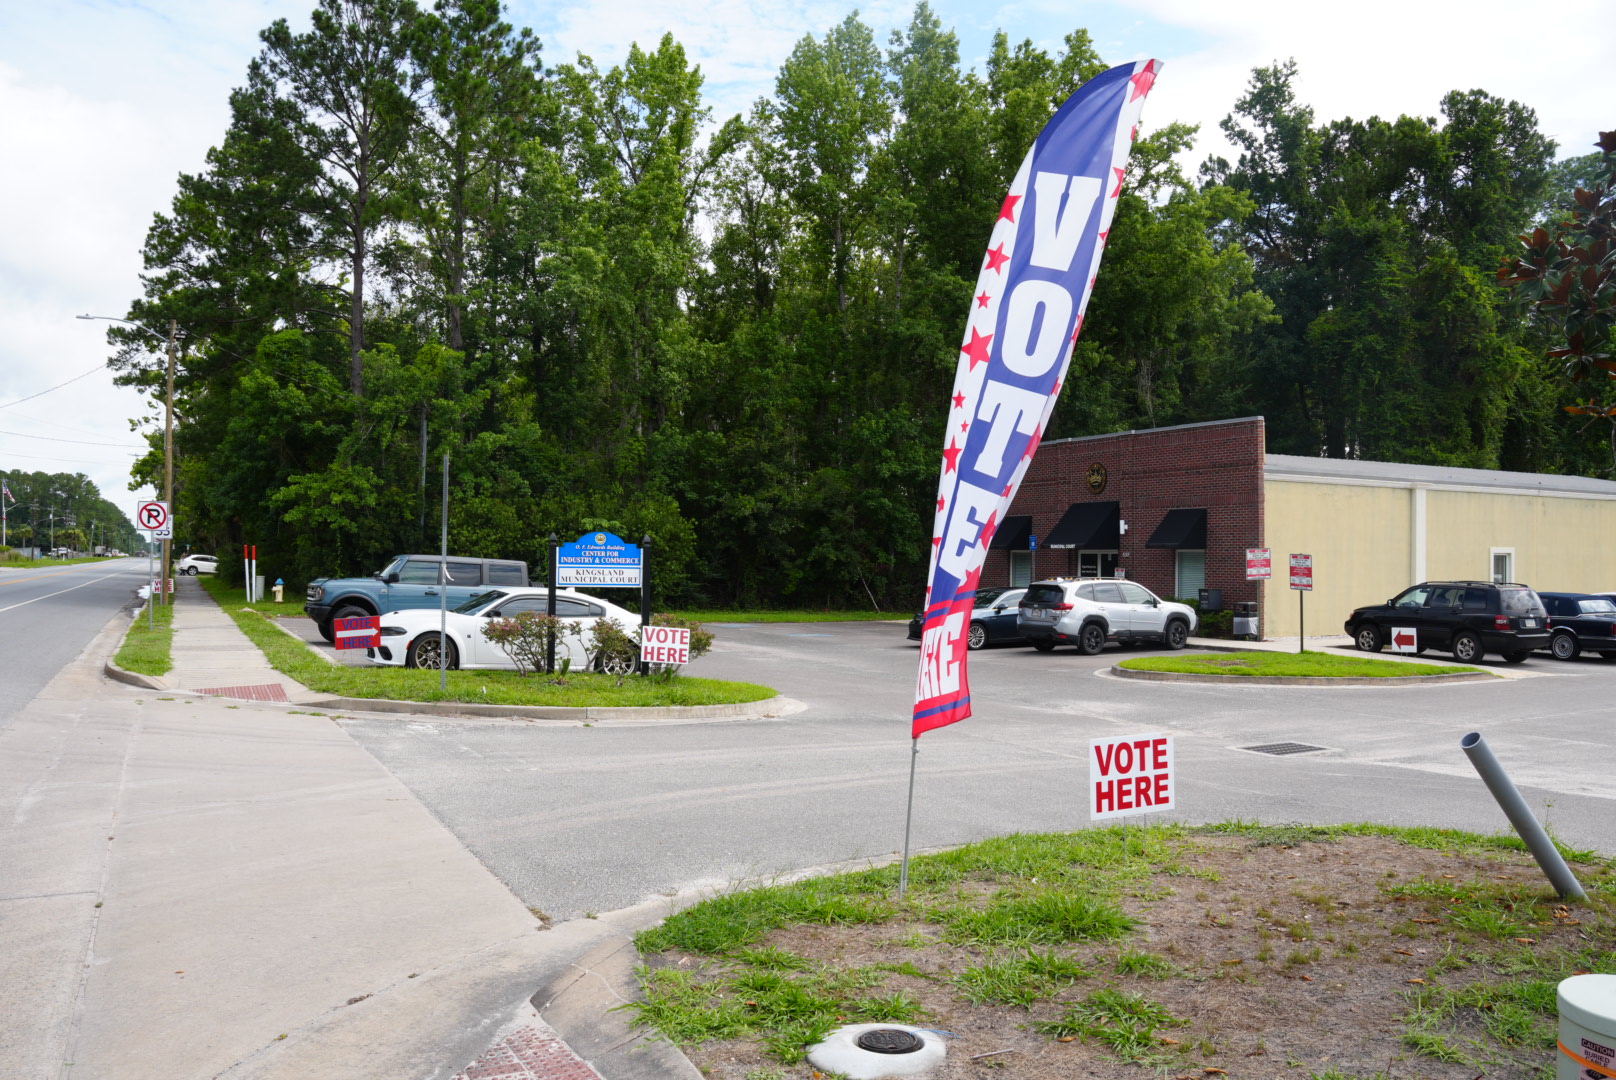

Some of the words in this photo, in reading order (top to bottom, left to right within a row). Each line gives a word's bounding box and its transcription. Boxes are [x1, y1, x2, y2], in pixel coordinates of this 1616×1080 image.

[938, 171, 1102, 585] VOTE
[341, 616, 373, 630] VOTE
[343, 635, 374, 648] HERE
[643, 627, 689, 645] VOTE
[643, 646, 688, 663] HERE
[1094, 738, 1168, 776] VOTE
[1096, 773, 1169, 813] HERE
[1583, 1040, 1614, 1057] CAUTION
[1585, 1050, 1610, 1064] BURIED
